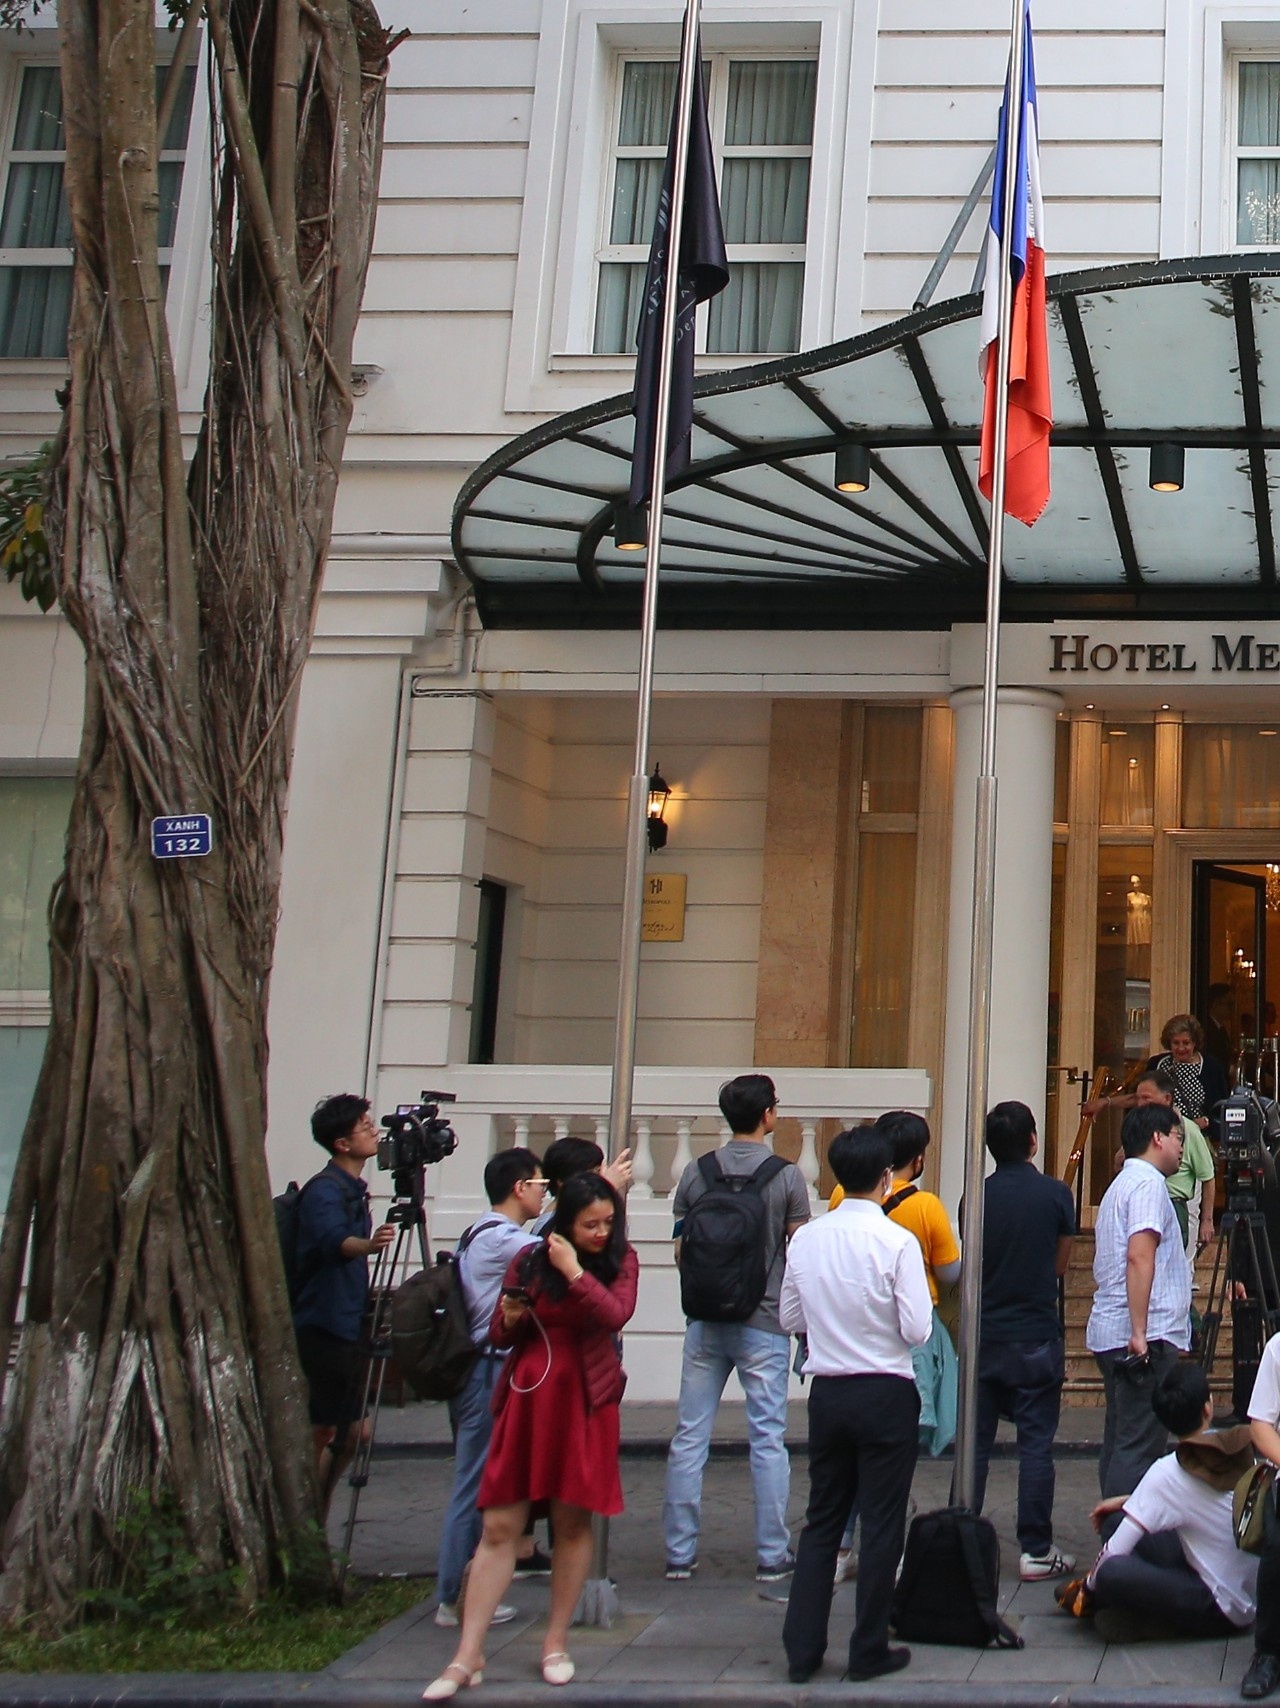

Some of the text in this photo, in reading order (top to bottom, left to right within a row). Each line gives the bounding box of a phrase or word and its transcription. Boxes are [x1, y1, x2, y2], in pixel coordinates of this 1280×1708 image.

[1049, 634, 1196, 672] HOTEL
[166, 820, 200, 832] XANH
[164, 838, 201, 852] 132
